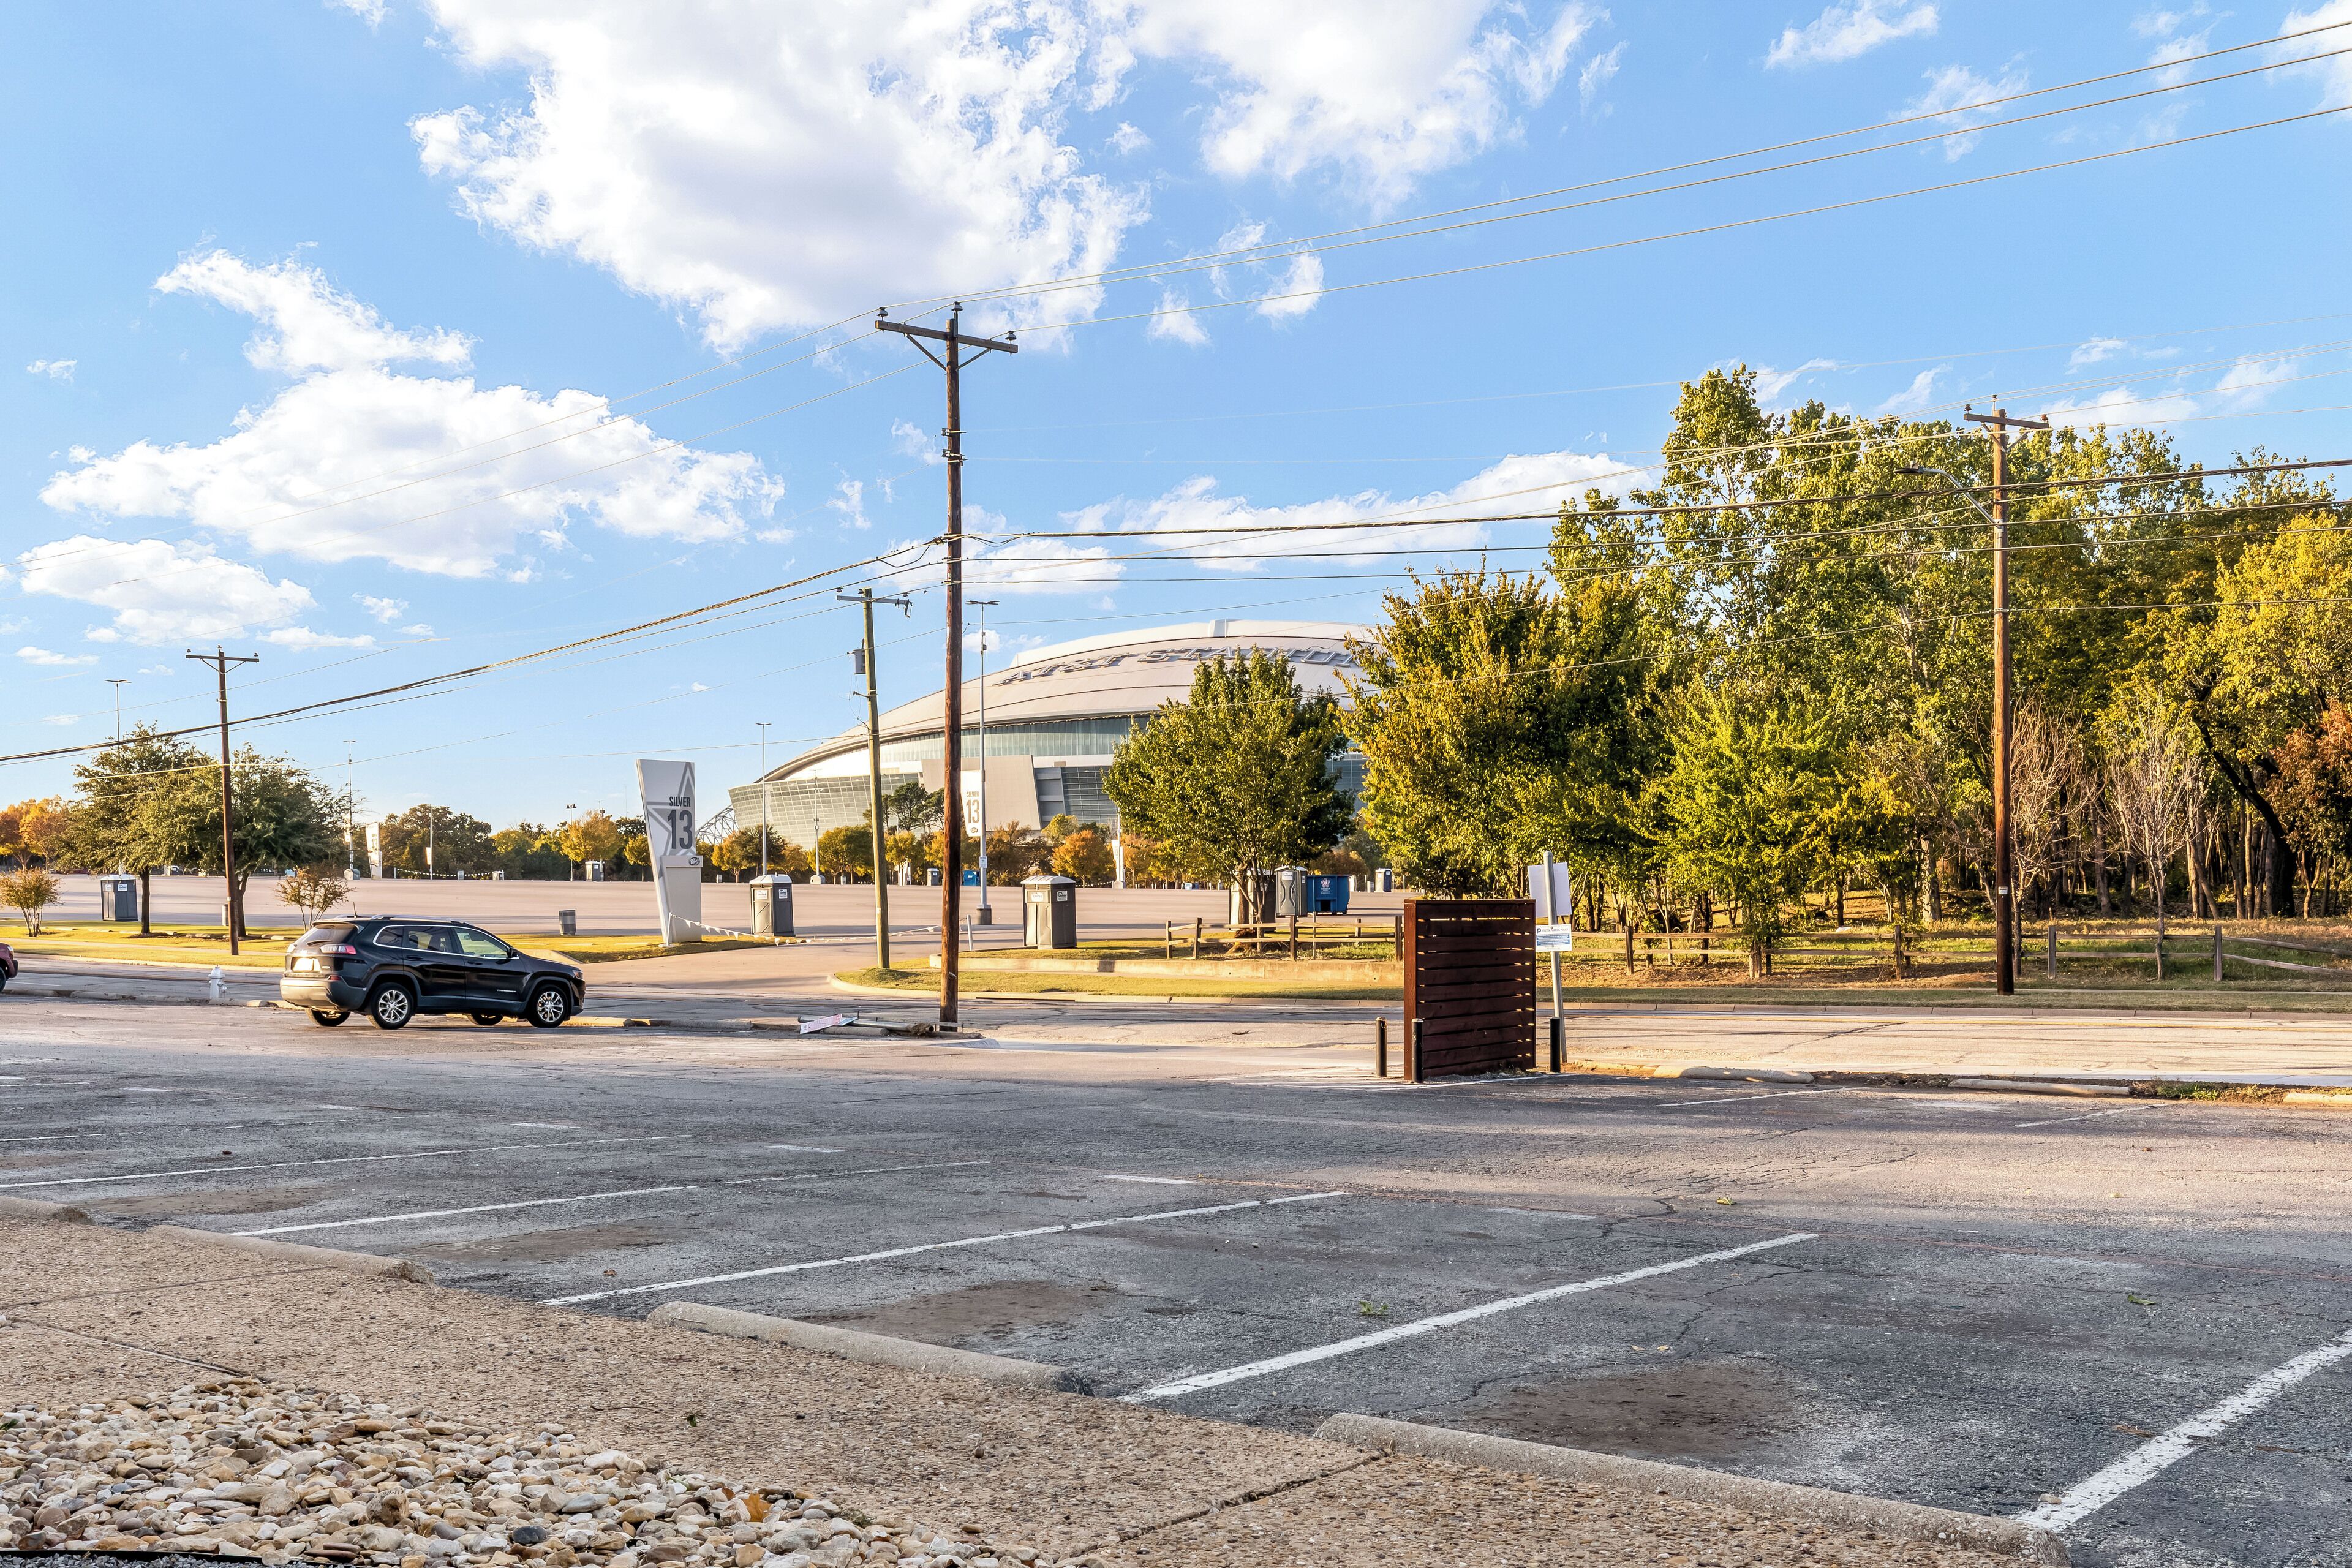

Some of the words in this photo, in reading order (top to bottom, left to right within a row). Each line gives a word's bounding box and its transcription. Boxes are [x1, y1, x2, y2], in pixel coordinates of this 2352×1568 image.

[992, 652, 1138, 687] AT&T
[669, 796, 691, 807] SILVER
[966, 799, 980, 824] 13
[668, 809, 693, 850] 13
